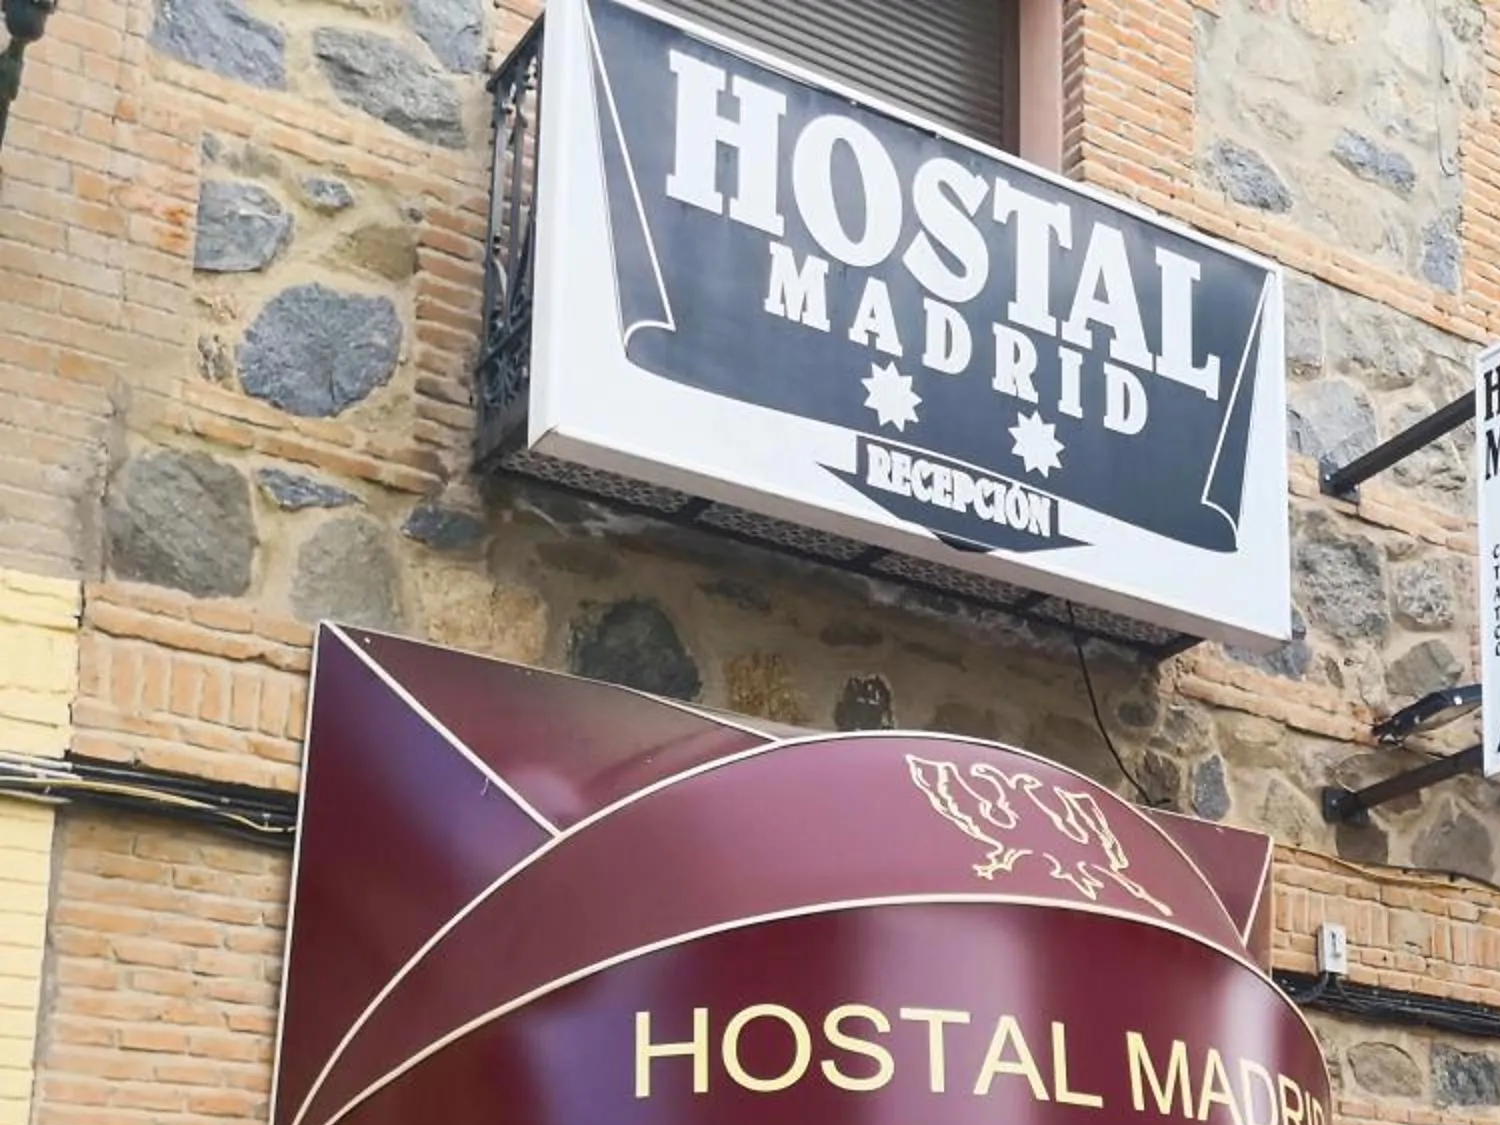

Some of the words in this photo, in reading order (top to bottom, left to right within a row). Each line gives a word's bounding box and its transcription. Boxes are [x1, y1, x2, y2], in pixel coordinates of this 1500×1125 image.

[665, 50, 1221, 399] HOSTAL
[764, 242, 1149, 436] MADRID
[866, 444, 1052, 537] RECEPCIÓN
[633, 1003, 1103, 1107] HOSTAL
